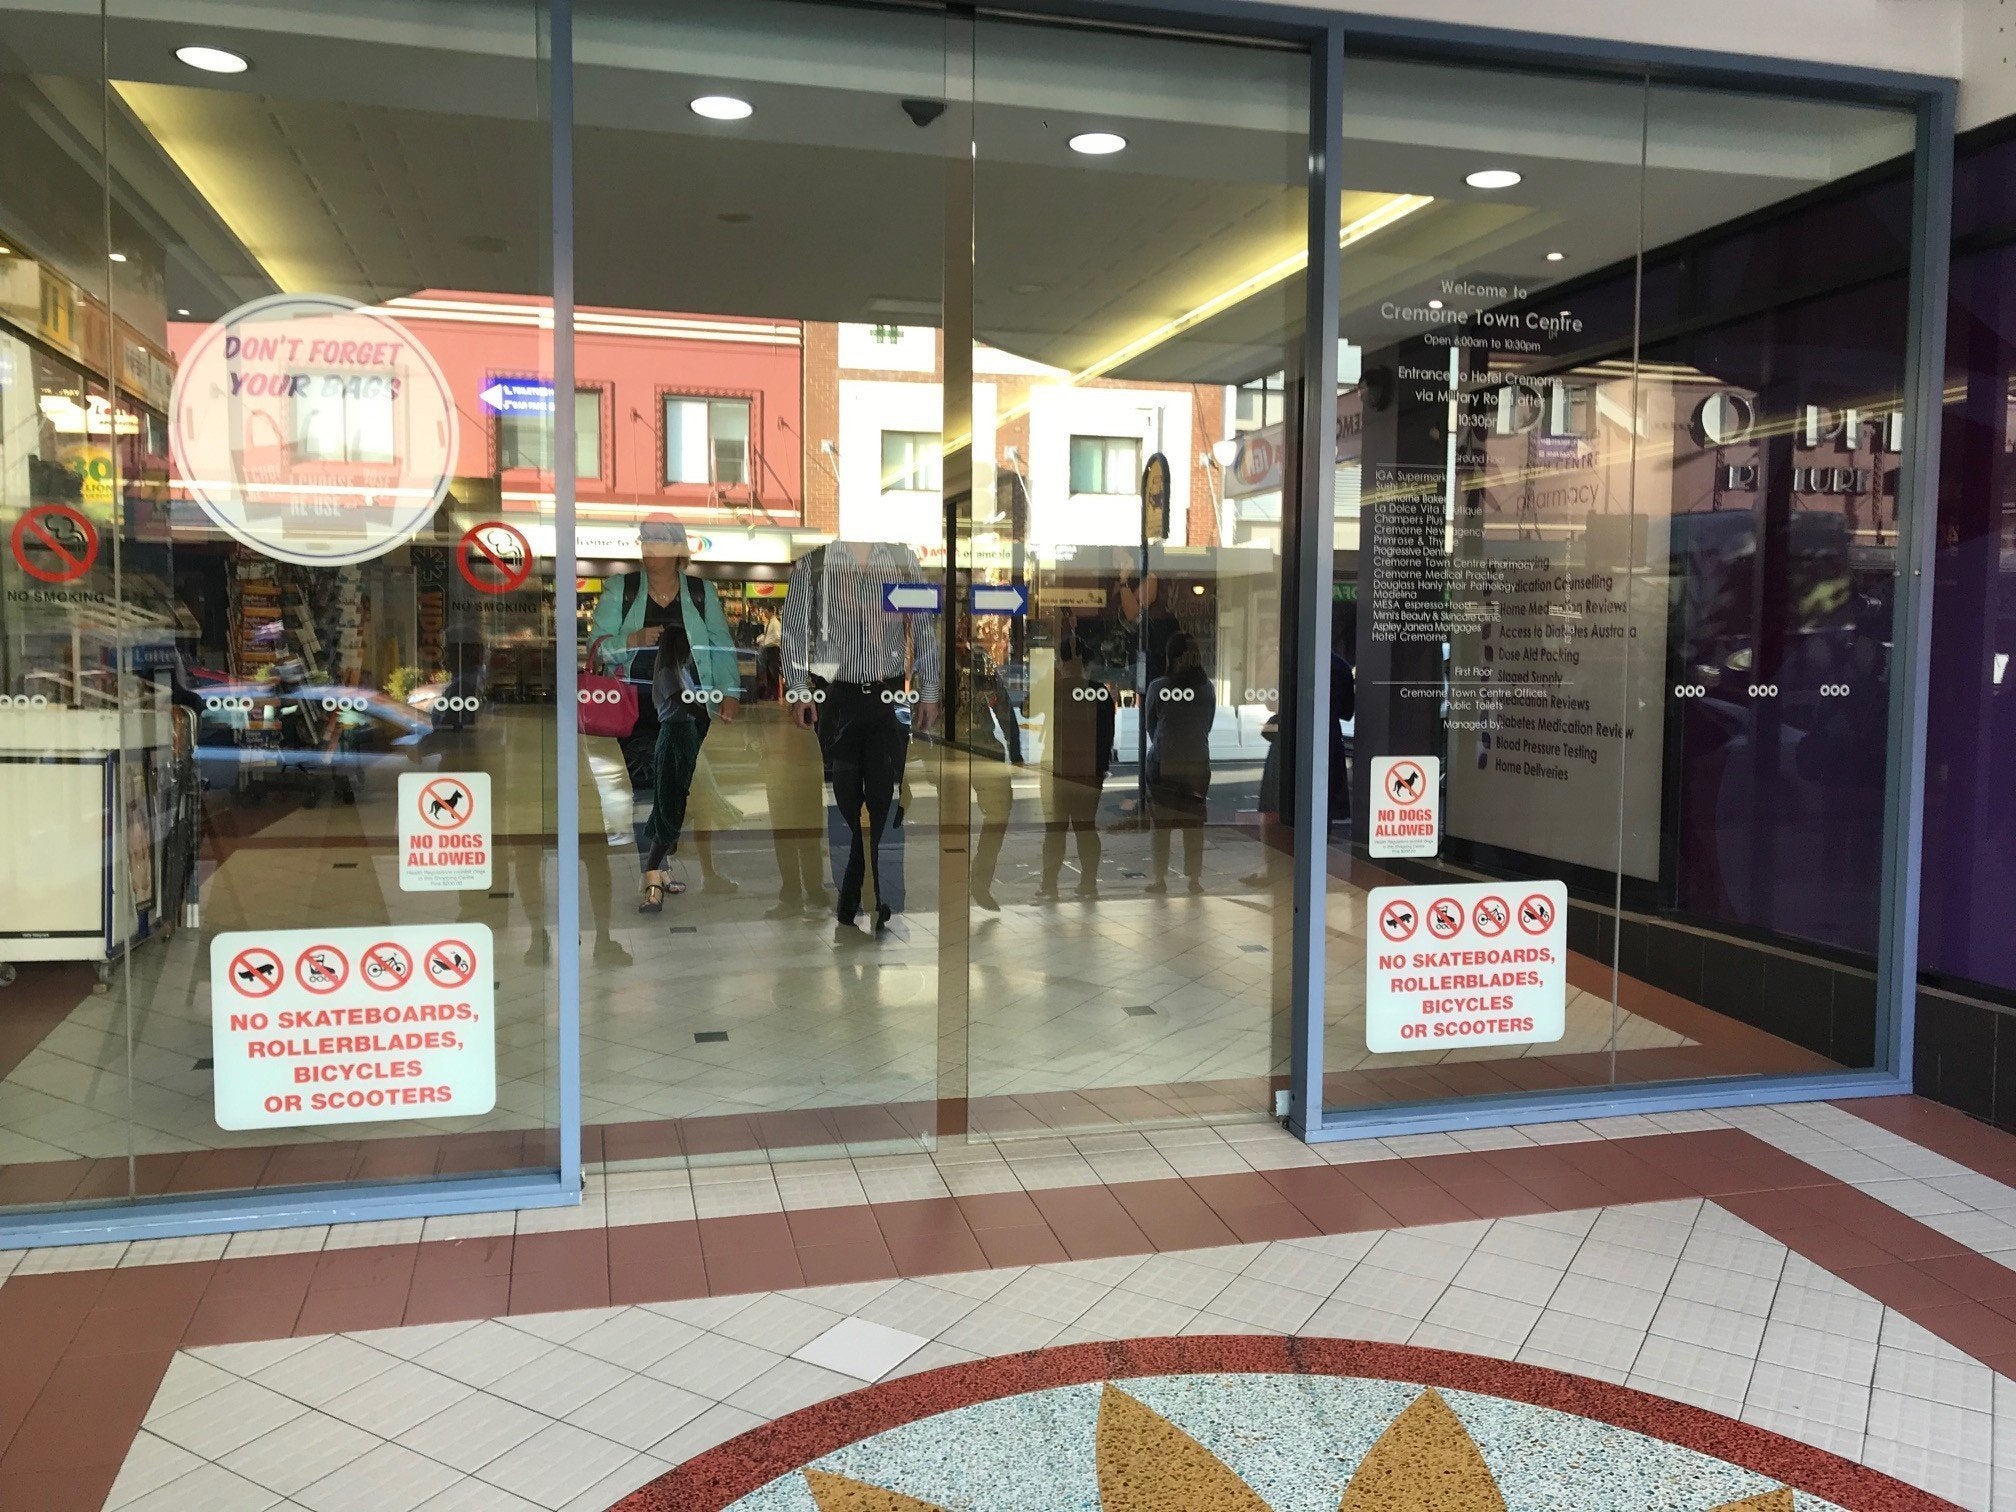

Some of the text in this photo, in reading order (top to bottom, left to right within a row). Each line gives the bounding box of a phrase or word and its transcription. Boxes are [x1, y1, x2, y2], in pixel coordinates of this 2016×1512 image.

[1441, 280, 1527, 299] Welcome to
[1381, 302, 1583, 333] Cremorne Town Centre
[1424, 333, 1451, 349] Open
[1491, 339, 1501, 349] to
[1504, 339, 1541, 352] 10:30pm
[225, 335, 403, 366] DON'T FORGET
[1398, 366, 1450, 382] Entrance
[1471, 370, 1502, 384] Hotel
[1505, 372, 1563, 387] Cremorne
[230, 372, 401, 400] YOUR BAGS
[1415, 389, 1435, 401] via
[1483, 393, 1514, 407] Rod
[1375, 470, 1447, 483] IGA Supermark
[1422, 496, 1447, 504] Bake
[1516, 484, 1598, 517] pharmacy
[1374, 503, 1483, 516] La Dolce Vita Butique
[1374, 513, 1444, 525] Champers Plus
[1374, 524, 1487, 538] Cremorne Newagency
[1374, 535, 1459, 548] Primrose & Thye
[1373, 545, 1451, 557] Progressive Denta
[1374, 556, 1421, 567] Cremorne
[1425, 557, 1450, 567] Town
[1454, 558, 1487, 568] Centre
[1374, 568, 1504, 581] Cremorne Medical Practice
[1373, 580, 1415, 591] Douglass
[1418, 581, 1443, 592] Hanly
[1470, 581, 1515, 593] Pathology
[1500, 578, 1551, 593] dication
[7, 590, 105, 603] NO SMOKING
[452, 601, 537, 614] NO SMOKING
[1373, 600, 1400, 609] MESA
[1401, 610, 1431, 622] Beauty
[1432, 611, 1439, 620] &
[1435, 622, 1481, 634] Mortgages
[1500, 624, 1531, 639] Access
[1534, 625, 1542, 637] to
[1592, 623, 1637, 638] Austraa
[1372, 632, 1447, 641] Hotel Cremorne
[1499, 647, 1580, 665] Dose Aid Packing
[1455, 666, 1493, 677] First Floor
[1531, 670, 1563, 688] Supply
[1400, 687, 1548, 698] Cremorne Town Centre Offices
[1445, 700, 1503, 710] Public Toilets
[1551, 694, 1590, 710] Reviews
[1443, 718, 1487, 731] Managed
[1538, 718, 1593, 736] Medication
[1496, 736, 1598, 764] Blood Pressure Testing
[1495, 757, 1569, 780] Home Deliveries
[1378, 809, 1432, 821] NO DOGS
[1376, 824, 1434, 836] ALLOWED
[410, 834, 483, 849] NO DOGS
[407, 851, 486, 866] ALLOWED
[1379, 948, 1555, 970] NO SKATEBOARDS,
[1390, 971, 1544, 993] ROLLERBLADES,
[1422, 995, 1514, 1014] BICYCLES
[230, 1003, 479, 1031] NO SKATEBOARDS,
[1400, 1017, 1534, 1039] OR SCOOTERS
[248, 1031, 464, 1058] ROLLERBLADES,
[294, 1061, 423, 1083] BICYCLES
[264, 1086, 453, 1114] OR SCOOTERS
